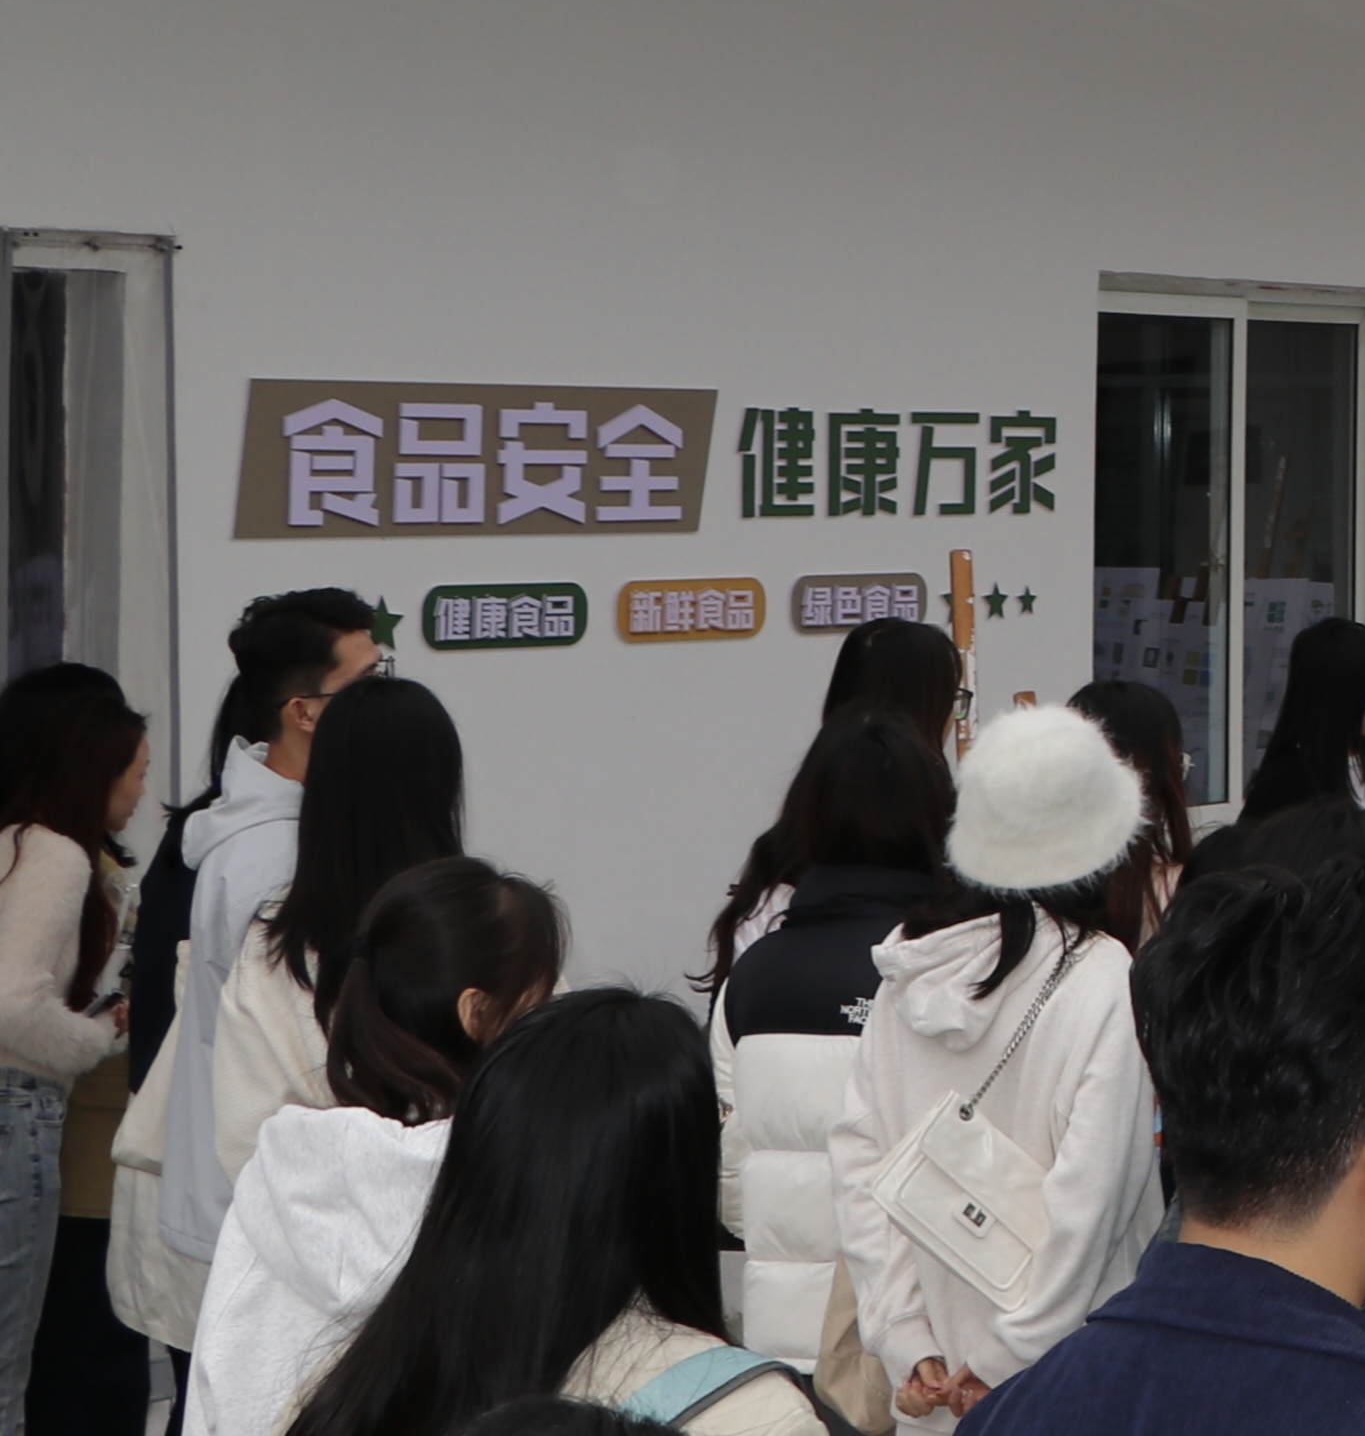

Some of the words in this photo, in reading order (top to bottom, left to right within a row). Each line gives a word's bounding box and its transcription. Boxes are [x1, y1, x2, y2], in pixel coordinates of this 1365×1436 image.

[282, 398, 685, 527] 食品安全
[738, 407, 1057, 518] 健康万家
[433, 594, 575, 642] 健康食品
[628, 586, 756, 634] 新鲜食品
[801, 583, 919, 629] 绿色食品
